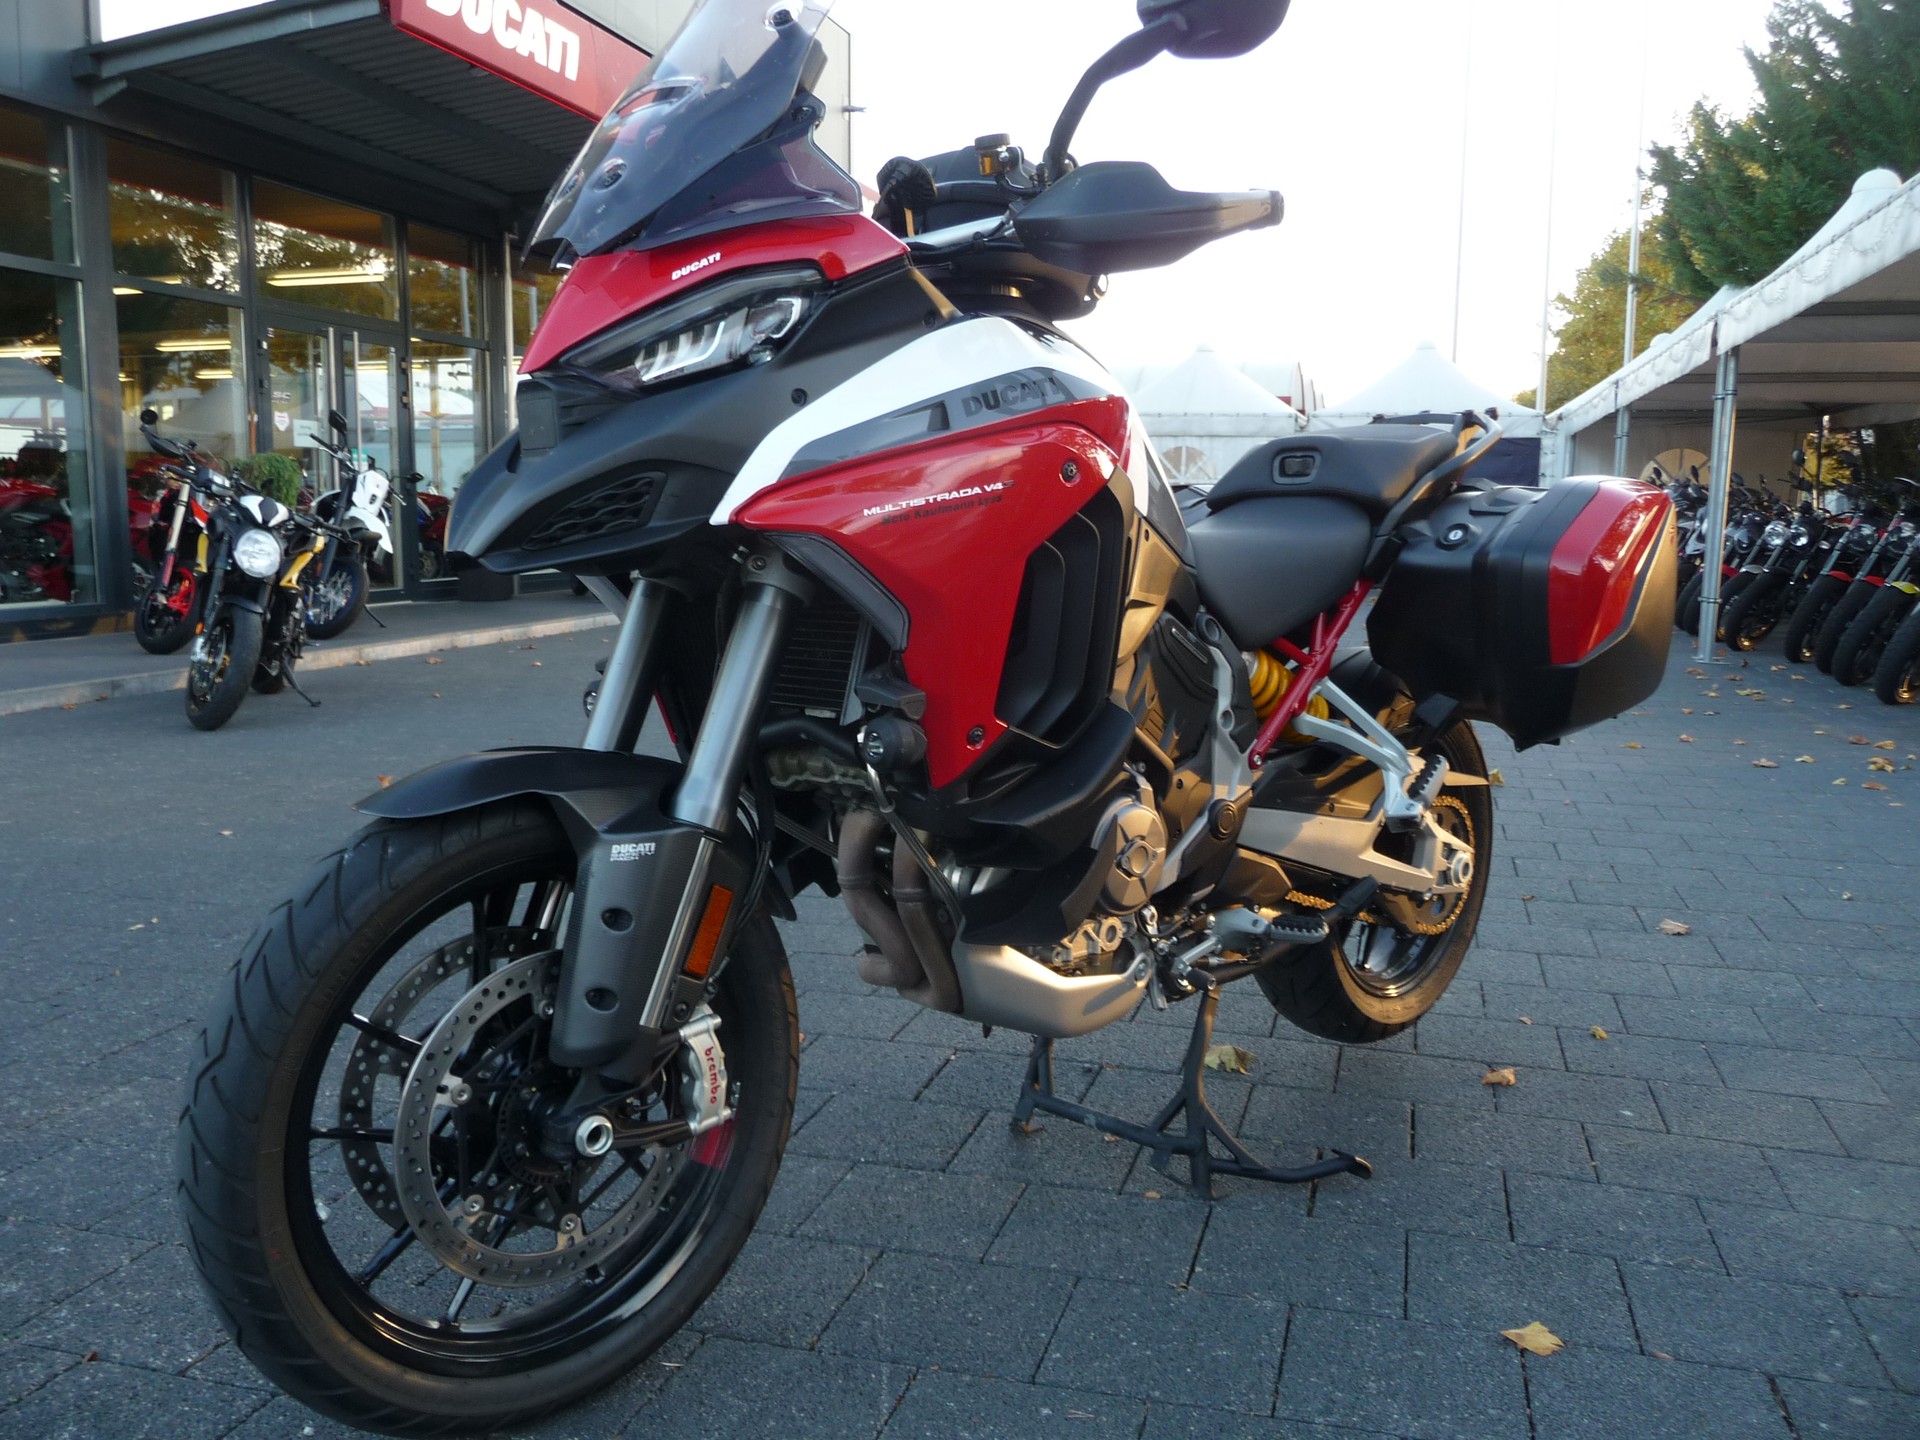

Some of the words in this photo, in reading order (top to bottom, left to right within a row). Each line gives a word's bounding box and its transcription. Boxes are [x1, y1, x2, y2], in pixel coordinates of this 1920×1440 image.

[671, 252, 721, 281] DUCATI
[863, 486, 982, 516] MULTISTRADA
[914, 501, 974, 518] Kaufmann
[611, 842, 656, 854] DUCATI
[704, 1046, 721, 1104] brembo
